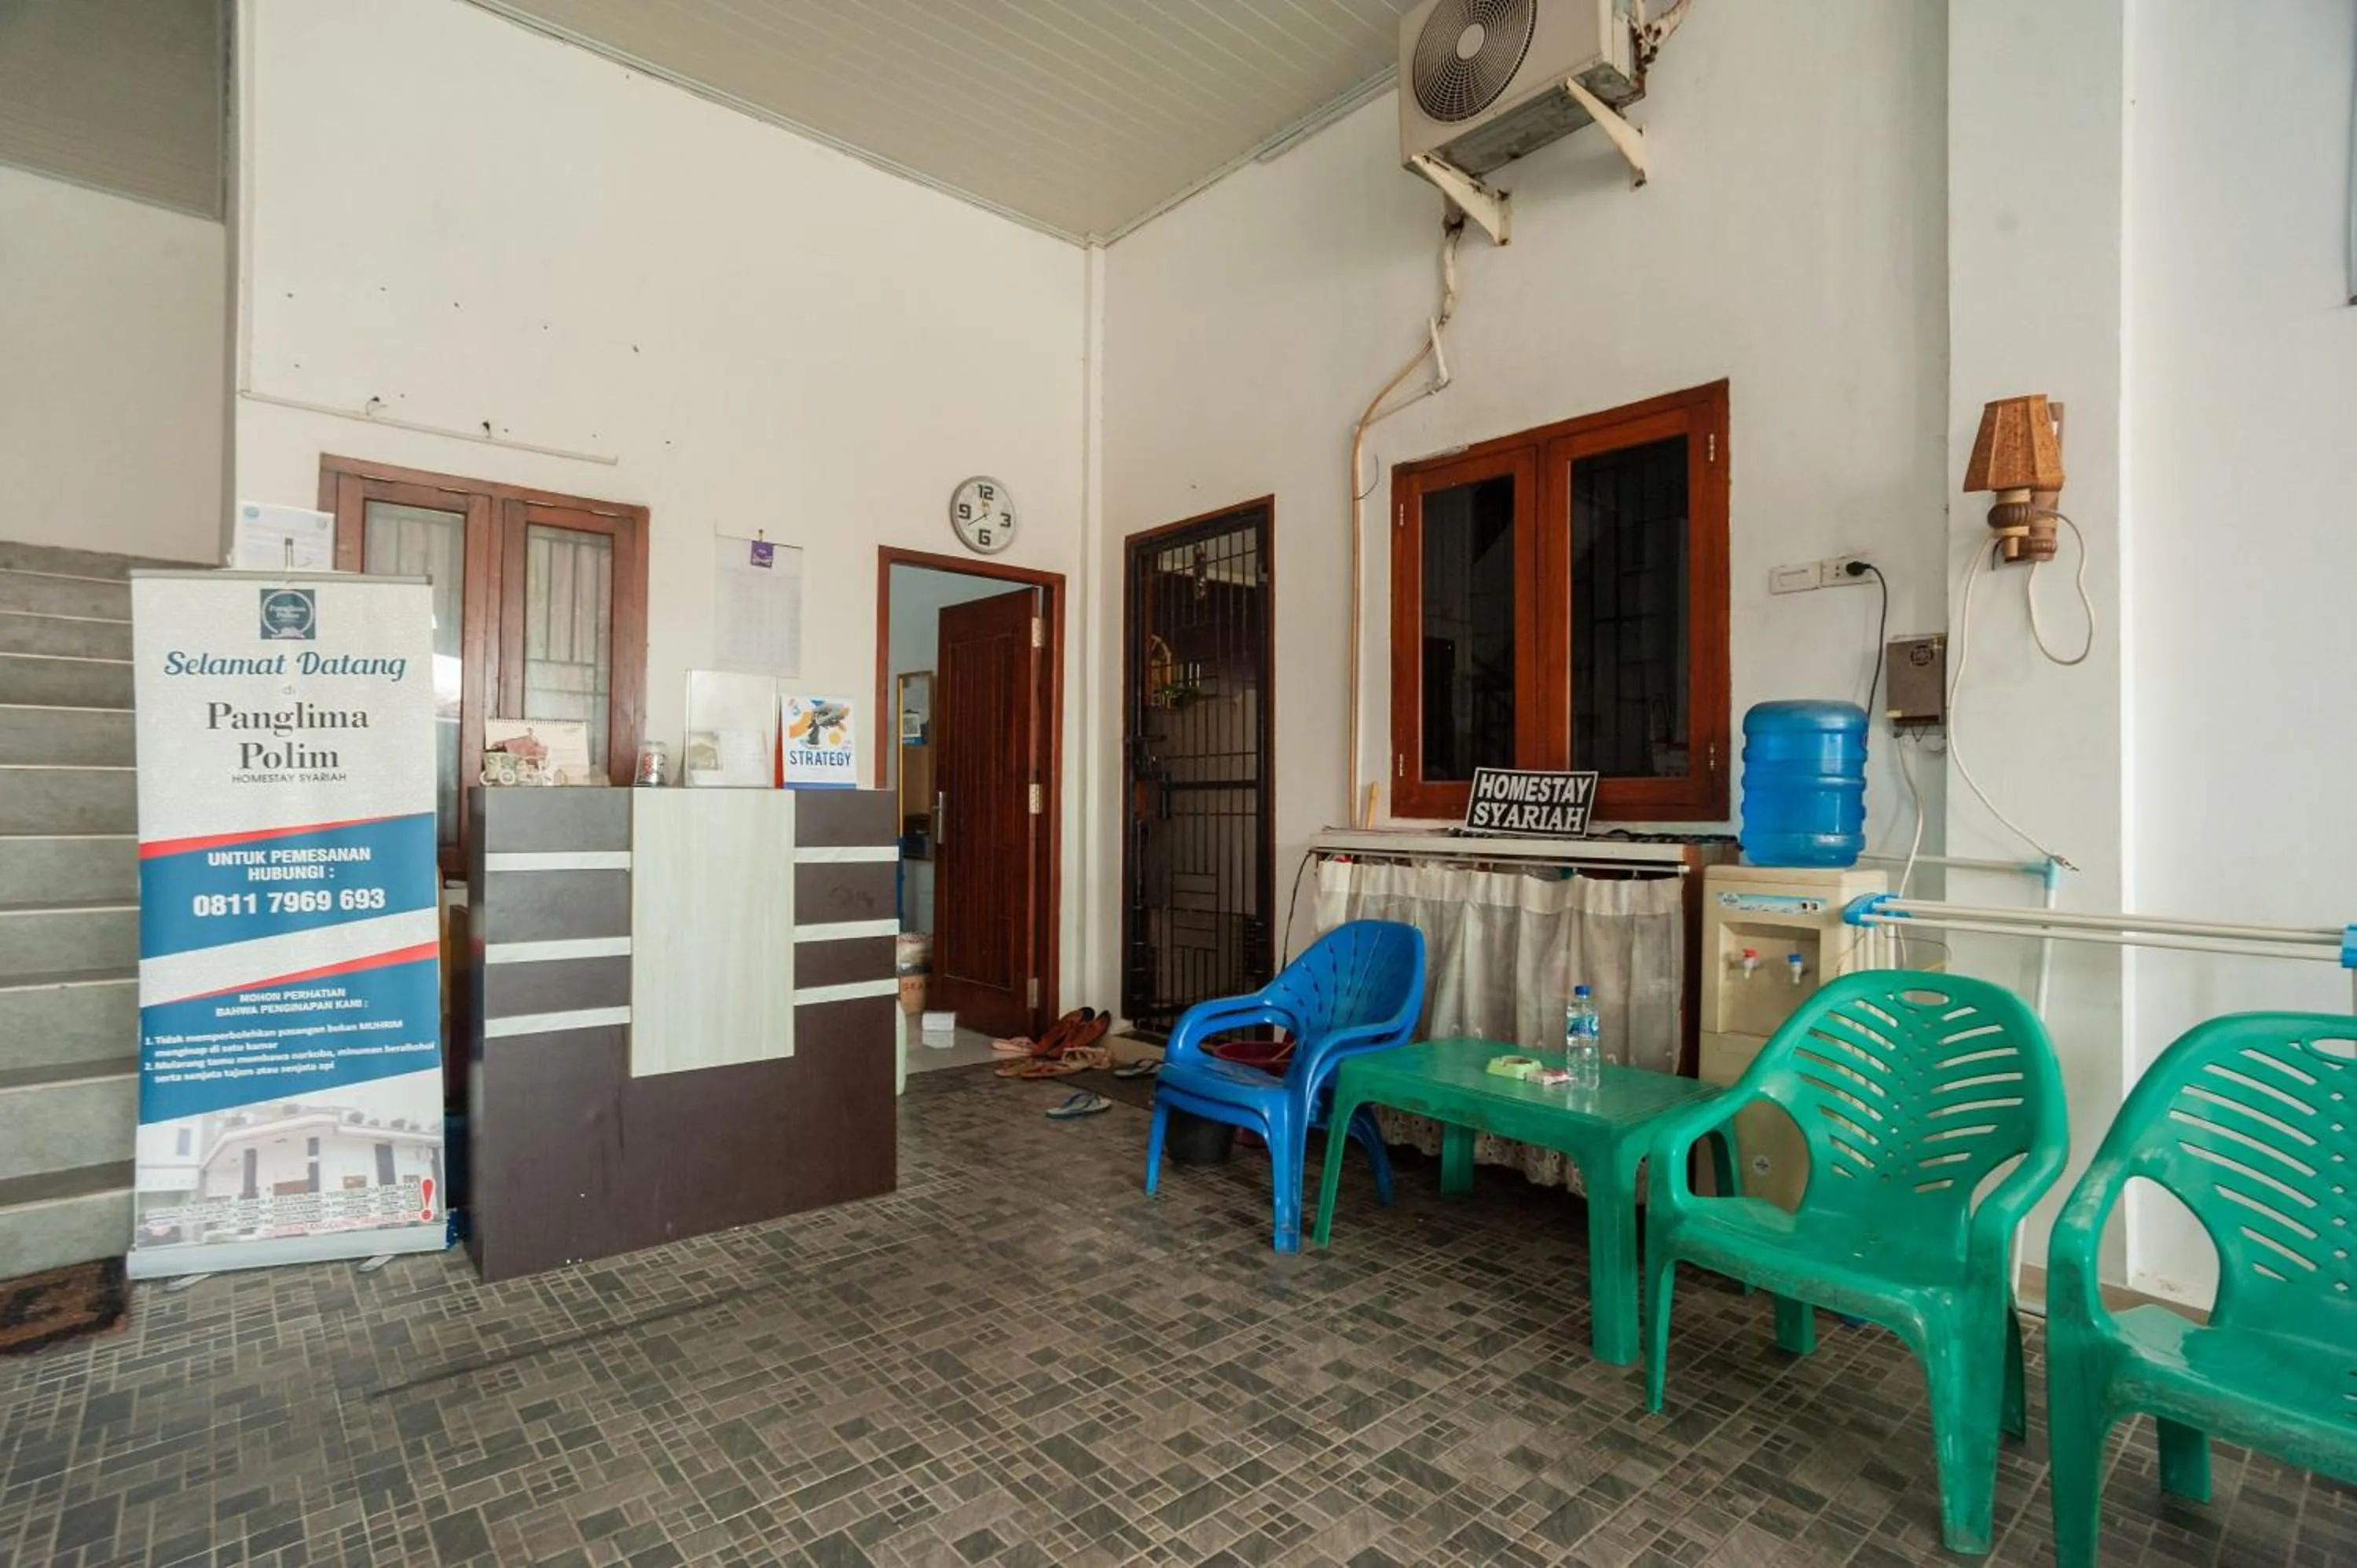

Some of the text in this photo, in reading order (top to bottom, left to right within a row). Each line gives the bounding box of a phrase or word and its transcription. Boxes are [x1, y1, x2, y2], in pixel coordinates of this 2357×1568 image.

[978, 484, 994, 500] 12
[959, 503, 971, 519] 9
[1000, 512, 1011, 528] 3
[978, 529, 991, 546] 6
[164, 650, 406, 682] Selamat Datang
[206, 702, 368, 737] Panglima
[238, 742, 339, 770] Polim
[789, 750, 851, 766] STRATEGY
[232, 772, 346, 783] HOMESTAY SYARIAH
[1478, 774, 1593, 804] HOMESTAY
[1473, 801, 1585, 831] SYARIAH
[207, 847, 371, 866] UNTUK PEMESANAN
[247, 866, 324, 881] HUBUNGI
[192, 888, 385, 917] 0811 7969 693
[239, 987, 346, 1003] MOHON PERHATIAN
[215, 1005, 258, 1017] BAHWA
[260, 1002, 333, 1015] PENGINAPAN
[335, 998, 362, 1009] KAMI
